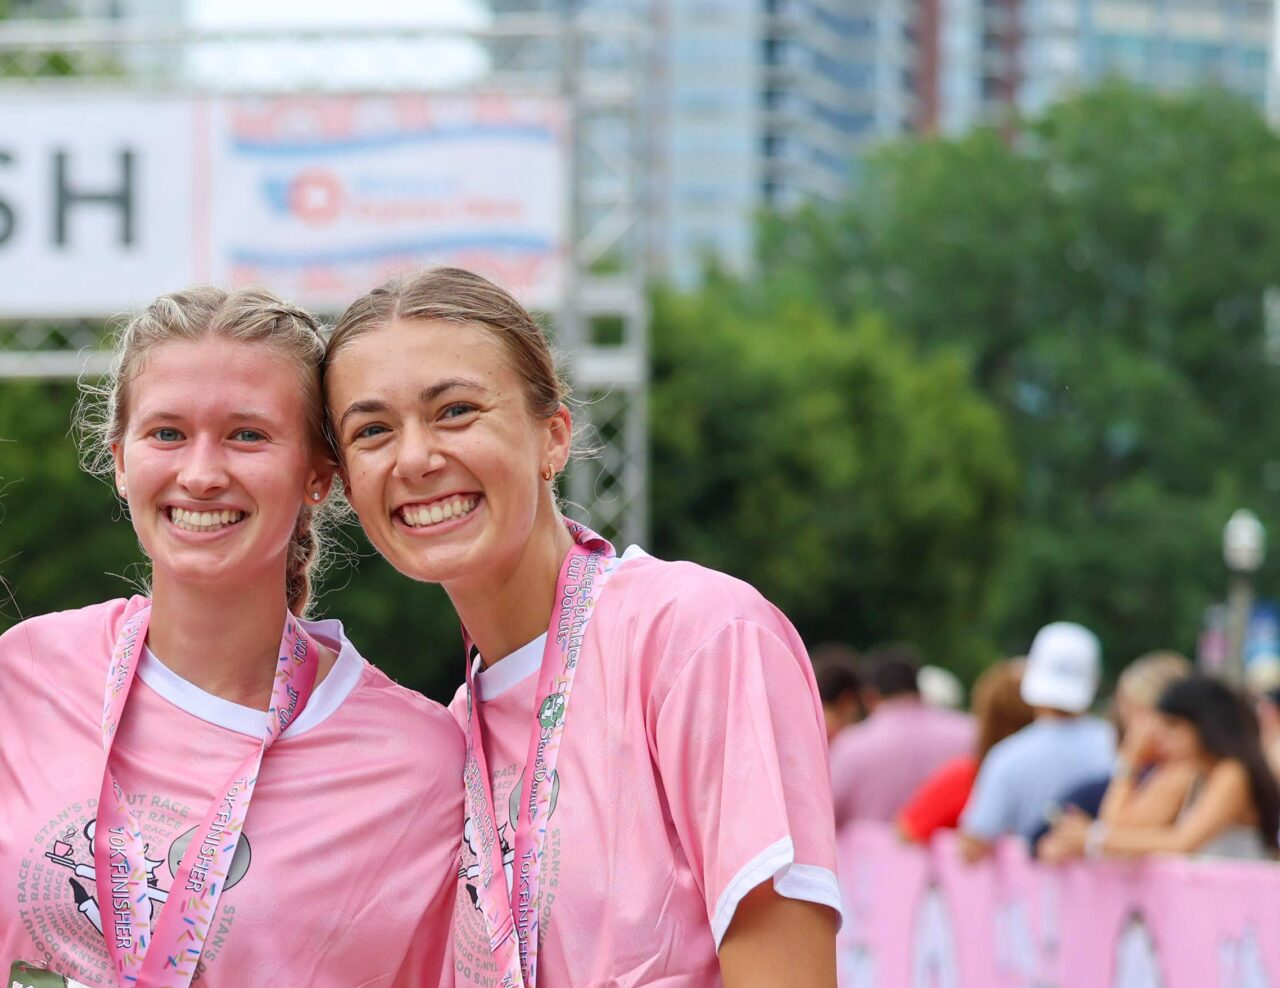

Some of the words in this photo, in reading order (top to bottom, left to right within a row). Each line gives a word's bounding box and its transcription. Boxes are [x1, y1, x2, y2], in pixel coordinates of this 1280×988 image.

[580, 552, 600, 594] hatever
[557, 585, 580, 645] Donuts
[566, 598, 593, 669] Sprinkles
[150, 795, 191, 818] RACE
[224, 777, 247, 811] 10K
[34, 802, 82, 844] STAN'S
[148, 811, 183, 830] RACE
[109, 828, 128, 860] 10K
[186, 811, 231, 893] FINISHER
[549, 828, 561, 888] STAN'S
[17, 858, 31, 903] RACE
[30, 862, 44, 901] RACE
[43, 867, 55, 901] RACE
[519, 851, 531, 888] 10K
[44, 905, 71, 943] DONUT
[110, 862, 133, 949] FINISHER
[20, 909, 53, 961] DONUT
[32, 906, 61, 953] DONUT
[204, 904, 236, 962] STAN'S
[62, 952, 103, 984] STAN'S
[475, 958, 498, 972] TAN'S
